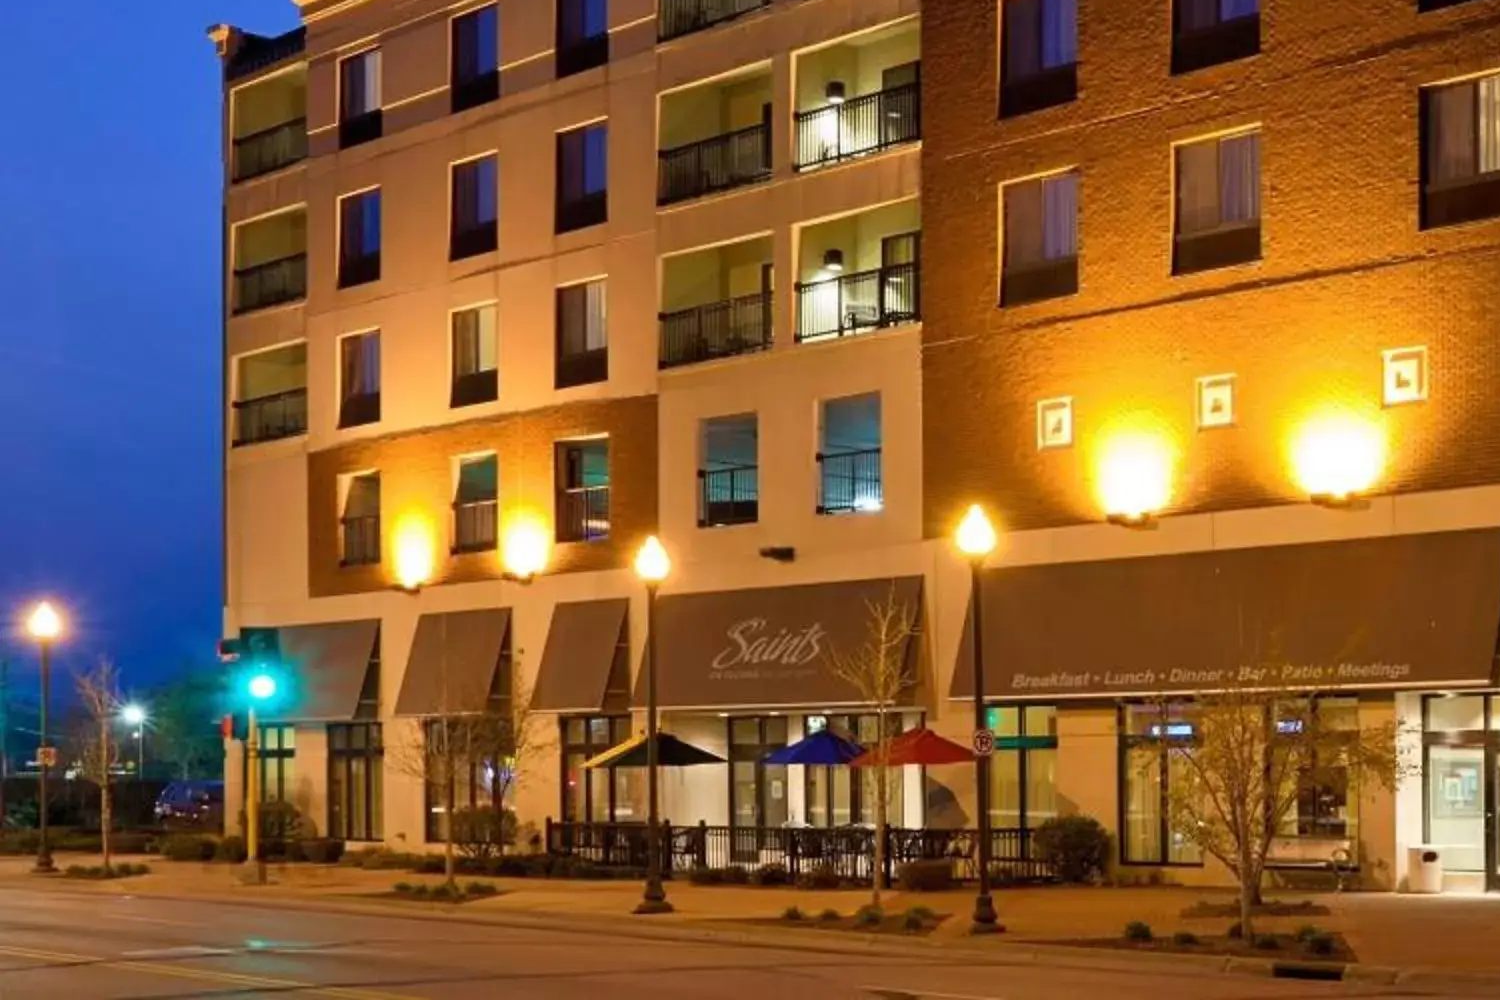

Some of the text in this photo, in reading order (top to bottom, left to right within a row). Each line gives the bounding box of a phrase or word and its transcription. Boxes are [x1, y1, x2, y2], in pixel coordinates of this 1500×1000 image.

[712, 617, 827, 669] Saints
[1012, 662, 1411, 689] Breakfast Lunch Dinner Bar Patio Meetings
